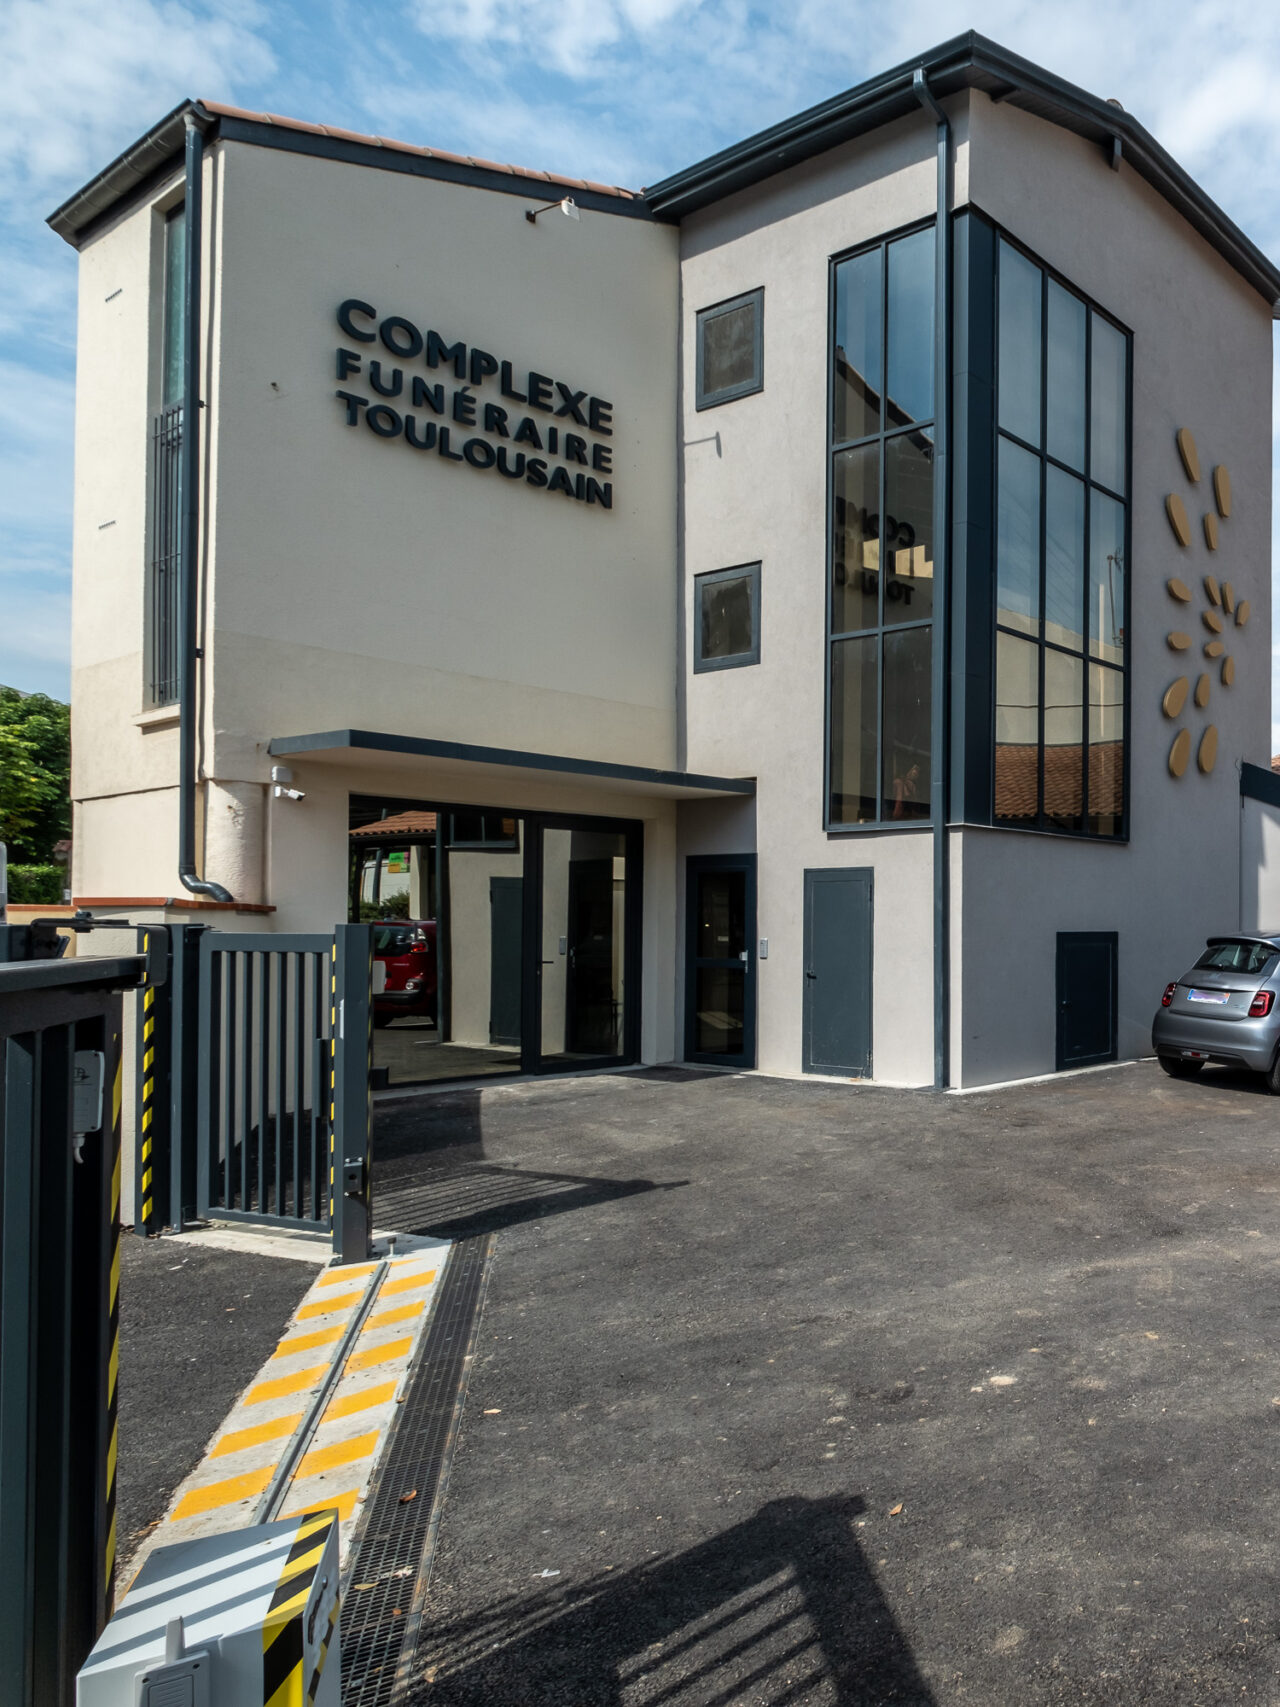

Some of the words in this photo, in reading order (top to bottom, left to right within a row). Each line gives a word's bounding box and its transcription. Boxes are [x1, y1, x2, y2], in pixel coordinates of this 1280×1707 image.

[336, 298, 613, 436] COMPLEXE
[336, 347, 613, 474] FUNÉRAIRE
[335, 389, 613, 509] TOULOUSAIN
